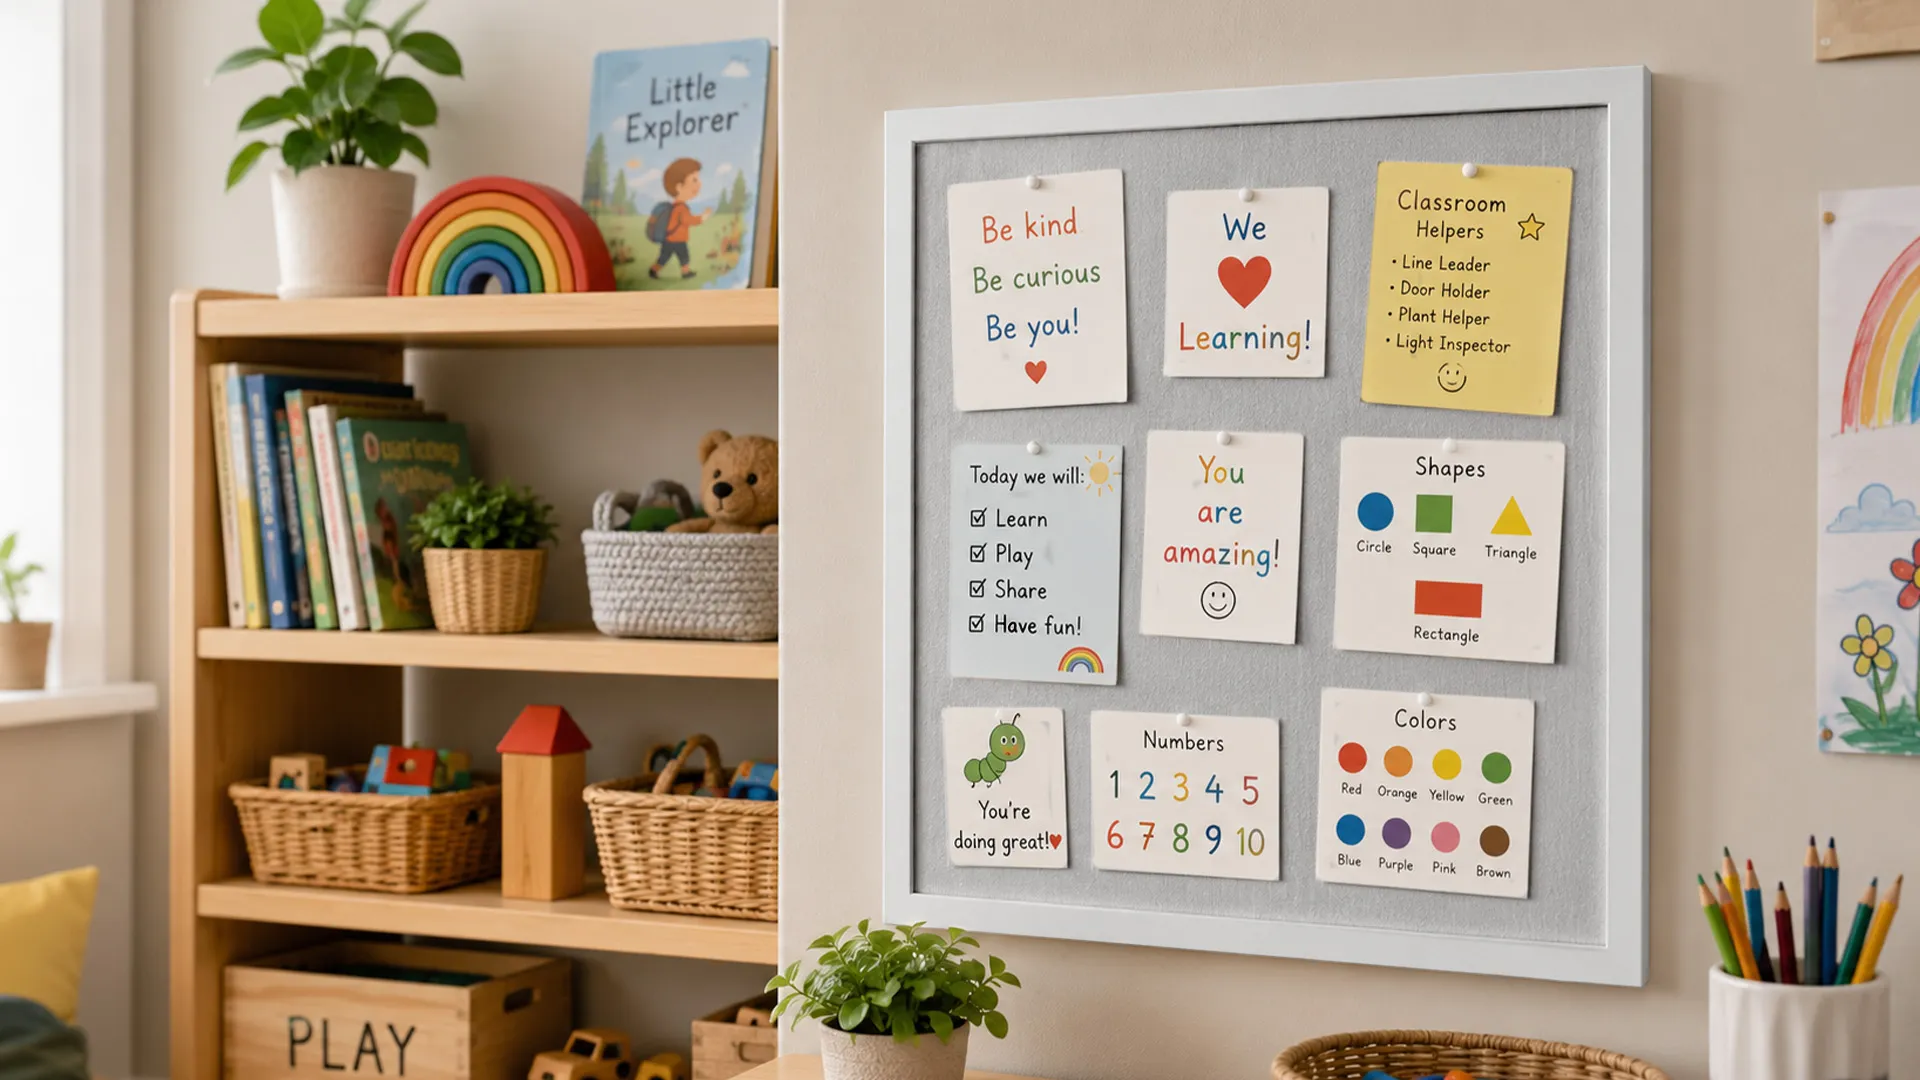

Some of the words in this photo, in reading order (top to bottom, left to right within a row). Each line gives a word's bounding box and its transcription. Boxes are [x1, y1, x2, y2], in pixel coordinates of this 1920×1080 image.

[650, 73, 717, 105] Little
[626, 110, 739, 149] Explorer
[1398, 189, 1507, 213] Classroom
[982, 216, 1013, 244] Be
[1025, 206, 1077, 239] kind
[1223, 212, 1267, 241] We
[1416, 220, 1484, 243] Helpers
[1402, 254, 1432, 270] Line
[1439, 255, 1491, 272] Leader
[973, 266, 1002, 294] Be
[1013, 264, 1101, 288] curious
[1401, 280, 1434, 296] Door
[1442, 282, 1490, 299] Holder
[986, 314, 1016, 342] Be
[1028, 307, 1080, 348] you!
[1399, 307, 1436, 323] Plant
[1443, 309, 1490, 329] Helper
[1179, 319, 1311, 361] Learning!
[1397, 333, 1433, 354] Light
[1440, 336, 1510, 356] Inspector
[970, 465, 1018, 491] Today
[1024, 471, 1046, 484] we
[1052, 468, 1085, 484] will:
[1198, 455, 1244, 484] You
[1416, 456, 1485, 483] Shapes
[996, 509, 1047, 528] Learn
[1198, 506, 1243, 524] are
[996, 543, 1033, 570] Play
[1163, 538, 1279, 577] amazing!
[1357, 540, 1392, 553] Circle
[1413, 542, 1456, 558] Square
[1485, 545, 1537, 563] Triangle
[995, 580, 1047, 599] Share
[995, 615, 1037, 634] Have
[1045, 616, 1081, 635] fun!
[1414, 626, 1479, 646] Rectangle
[1395, 709, 1457, 730] Colors
[1144, 730, 1224, 751] Numbers
[1110, 770, 1119, 798] 1
[1139, 772, 1155, 800] 2
[1173, 773, 1189, 802] 3
[1205, 774, 1223, 803] 4
[1242, 776, 1259, 805] 5
[1341, 782, 1362, 795] Red
[1378, 786, 1417, 802] Orange
[1429, 789, 1465, 802] Yellow
[1478, 793, 1512, 806] Green
[978, 800, 1031, 820] You're
[954, 831, 996, 856] doing
[1002, 831, 1049, 856] great!
[1107, 820, 1123, 849] 6
[1139, 822, 1155, 850] 7
[1173, 823, 1189, 853] 8
[1206, 824, 1221, 854] 9
[1237, 827, 1264, 856] 10
[1338, 854, 1361, 867] Blue
[1379, 857, 1413, 873] Purple
[1433, 862, 1456, 874] Pink
[1476, 866, 1511, 878] Brown
[288, 1015, 415, 1077] PLAY
